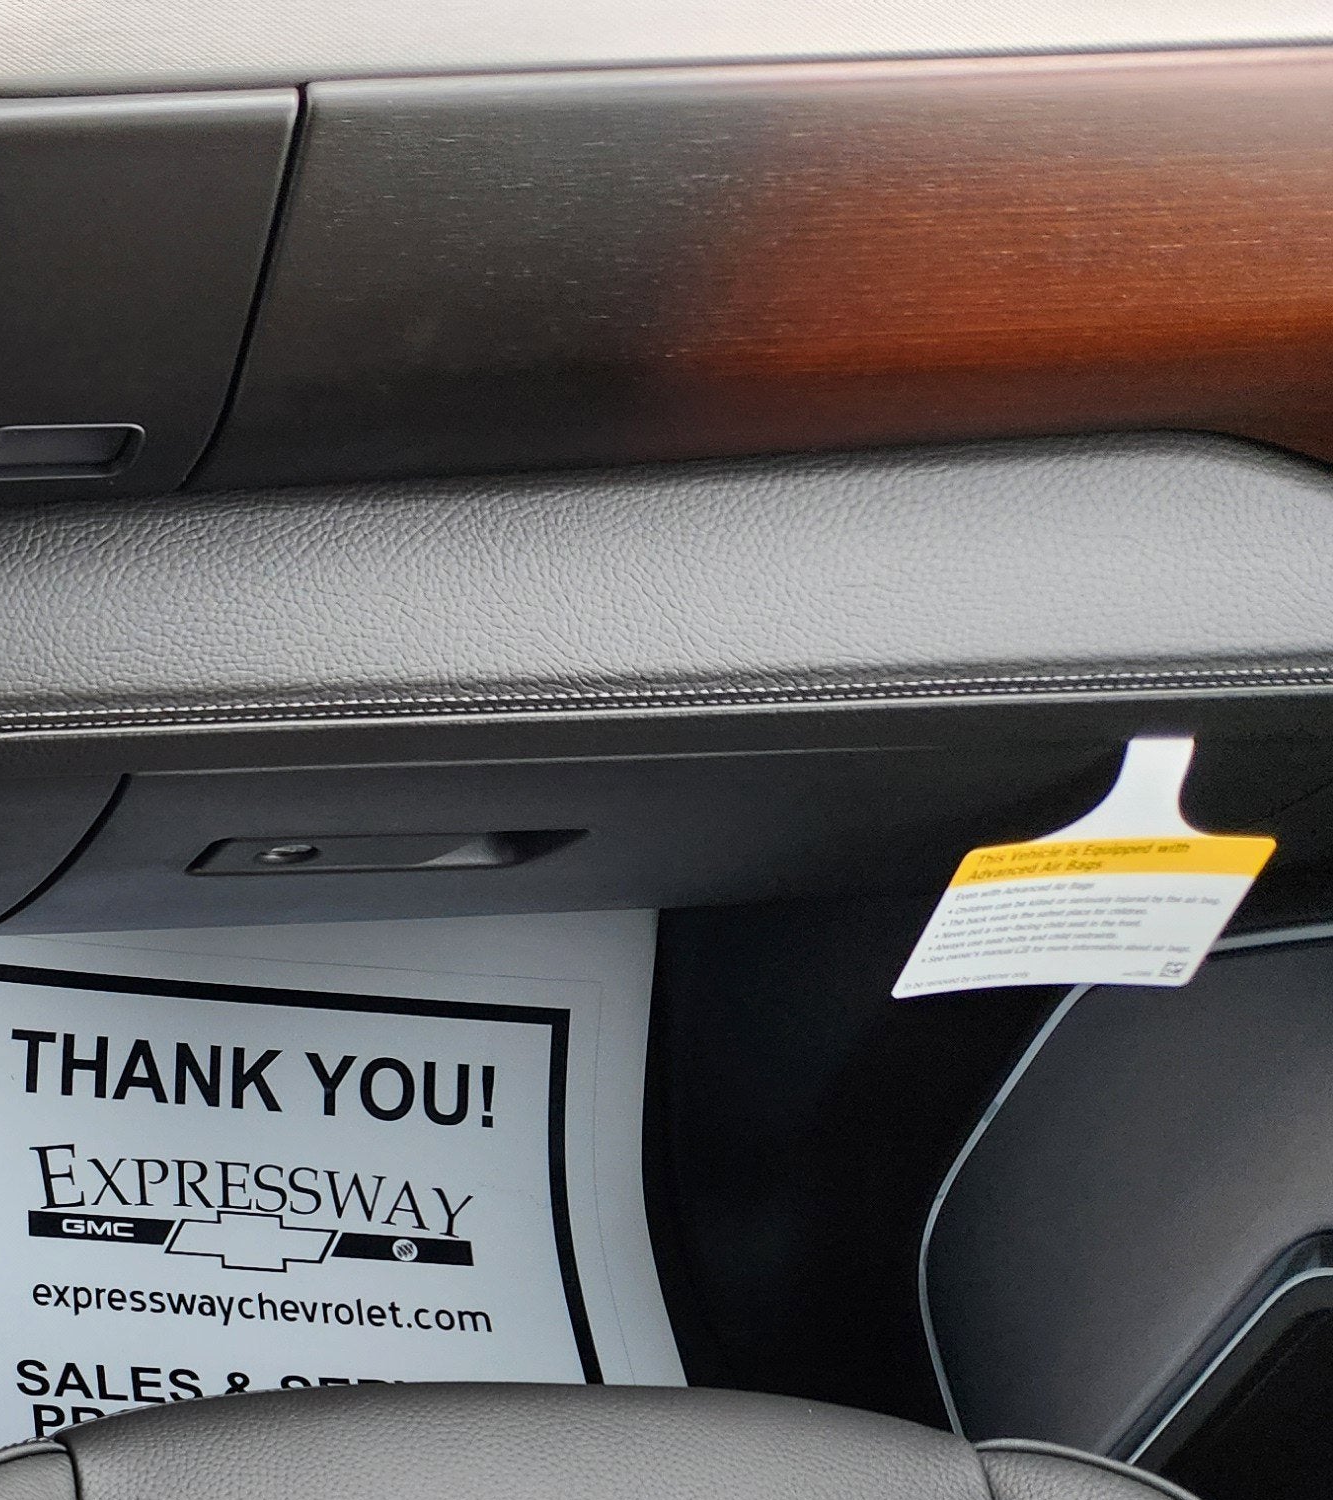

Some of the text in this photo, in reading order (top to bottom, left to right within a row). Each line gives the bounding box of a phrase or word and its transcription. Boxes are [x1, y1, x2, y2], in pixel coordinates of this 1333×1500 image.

[11, 1029, 496, 1128] THANK YOU!
[29, 1144, 475, 1239] EXPRESSWAY
[61, 1218, 134, 1238] GMC
[31, 1282, 492, 1333] expresswaychevrolet.com
[16, 1359, 203, 1403] SALES
[224, 1371, 251, 1394] &
